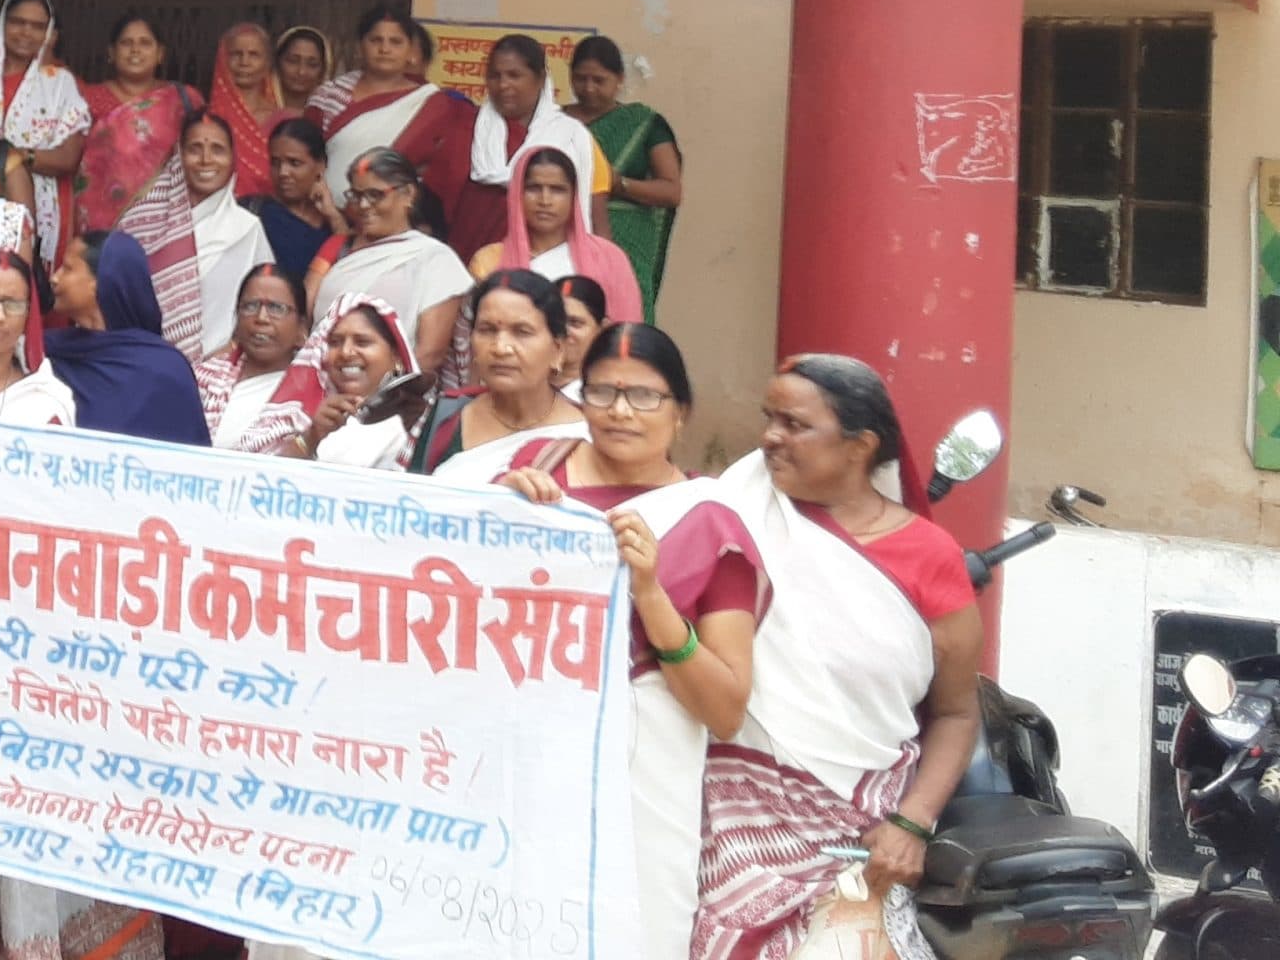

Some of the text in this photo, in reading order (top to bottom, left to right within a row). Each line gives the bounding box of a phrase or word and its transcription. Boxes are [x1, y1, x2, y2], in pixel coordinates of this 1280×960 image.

[249, 472, 338, 527] सेविका
[343, 494, 471, 544] सहायिका
[188, 538, 483, 675] कर्मचारी
[482, 567, 611, 692] संघ
[138, 648, 209, 691] पूरी
[121, 695, 192, 747] यही
[198, 714, 303, 768] हमारा
[312, 730, 410, 783] नारा
[90, 748, 222, 806] सरकार
[227, 765, 266, 811] से
[270, 781, 401, 833] मान्यता
[92, 833, 219, 899] रोहतास
[258, 830, 355, 876] पटना
